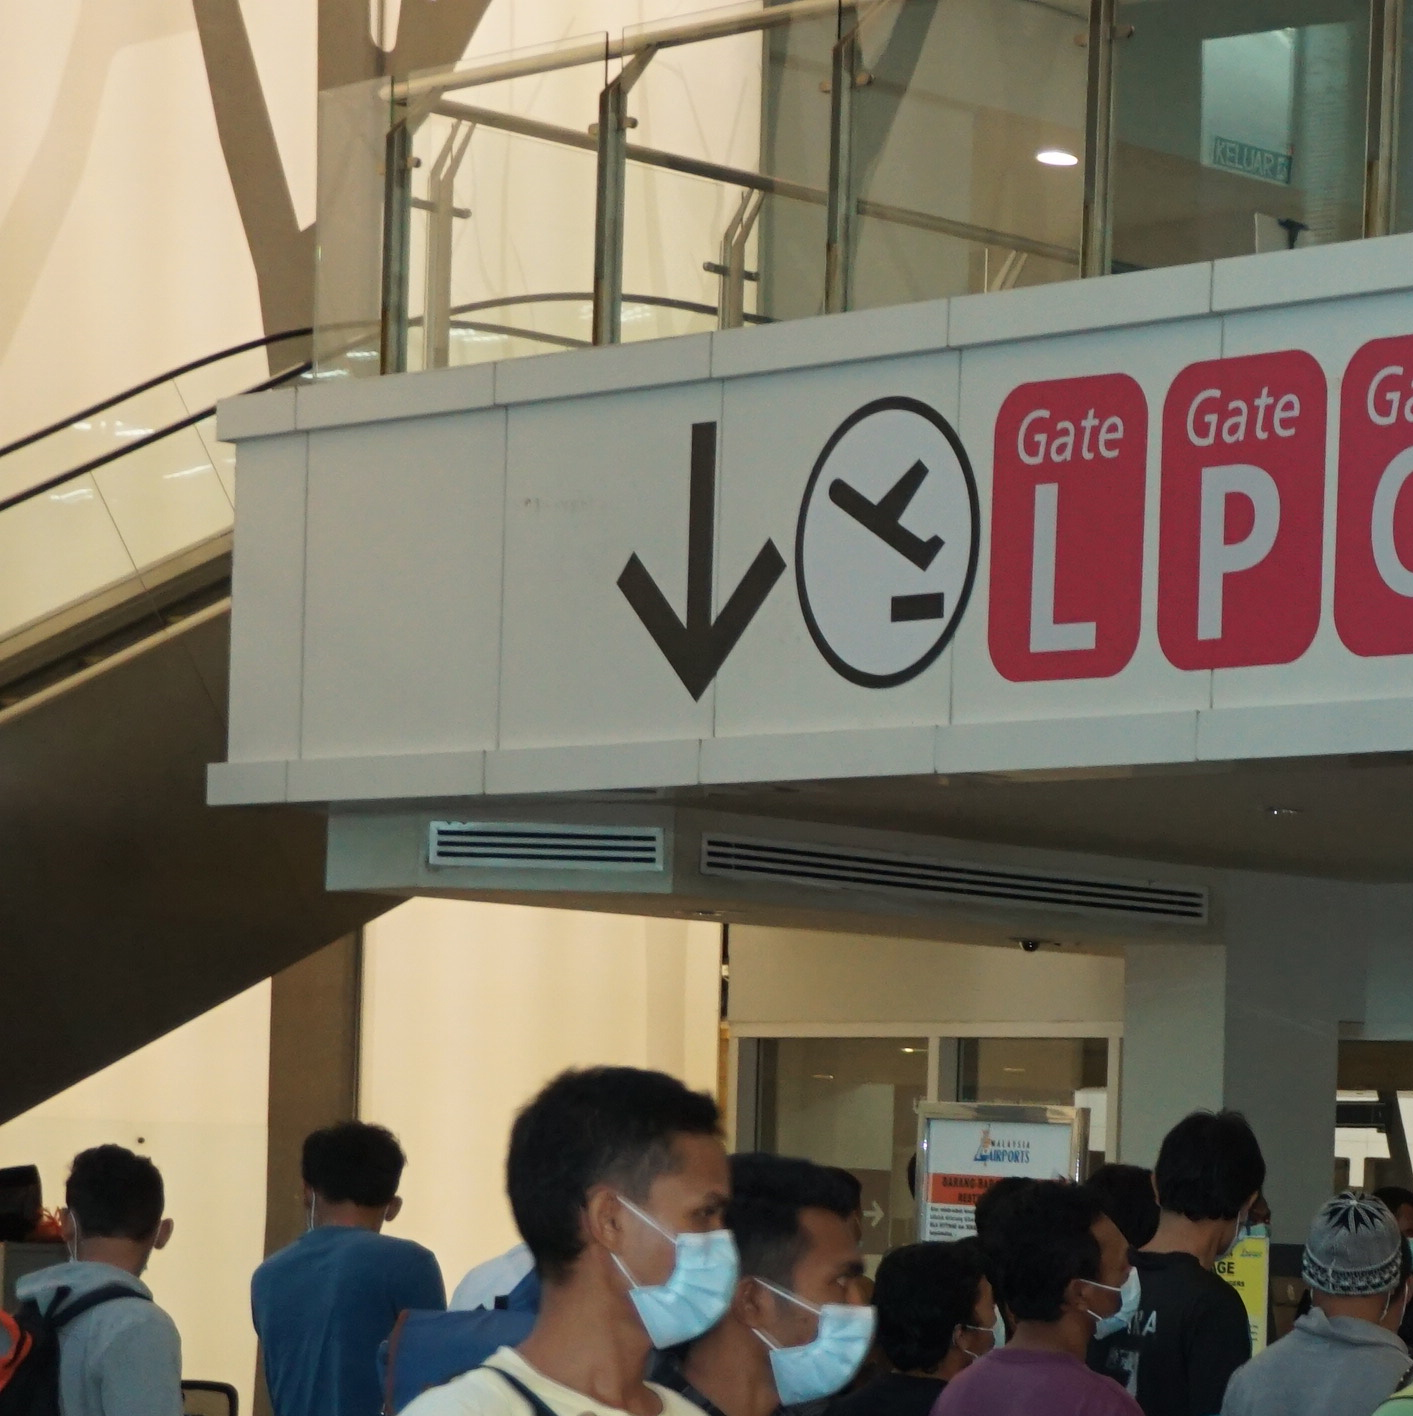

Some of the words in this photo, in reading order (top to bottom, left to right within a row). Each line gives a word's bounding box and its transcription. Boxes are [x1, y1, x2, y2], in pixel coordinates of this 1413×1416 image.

[1017, 405, 1125, 467] Gate
[1186, 384, 1301, 448] Gate
[1029, 482, 1097, 653] L
[1197, 463, 1281, 641] P
